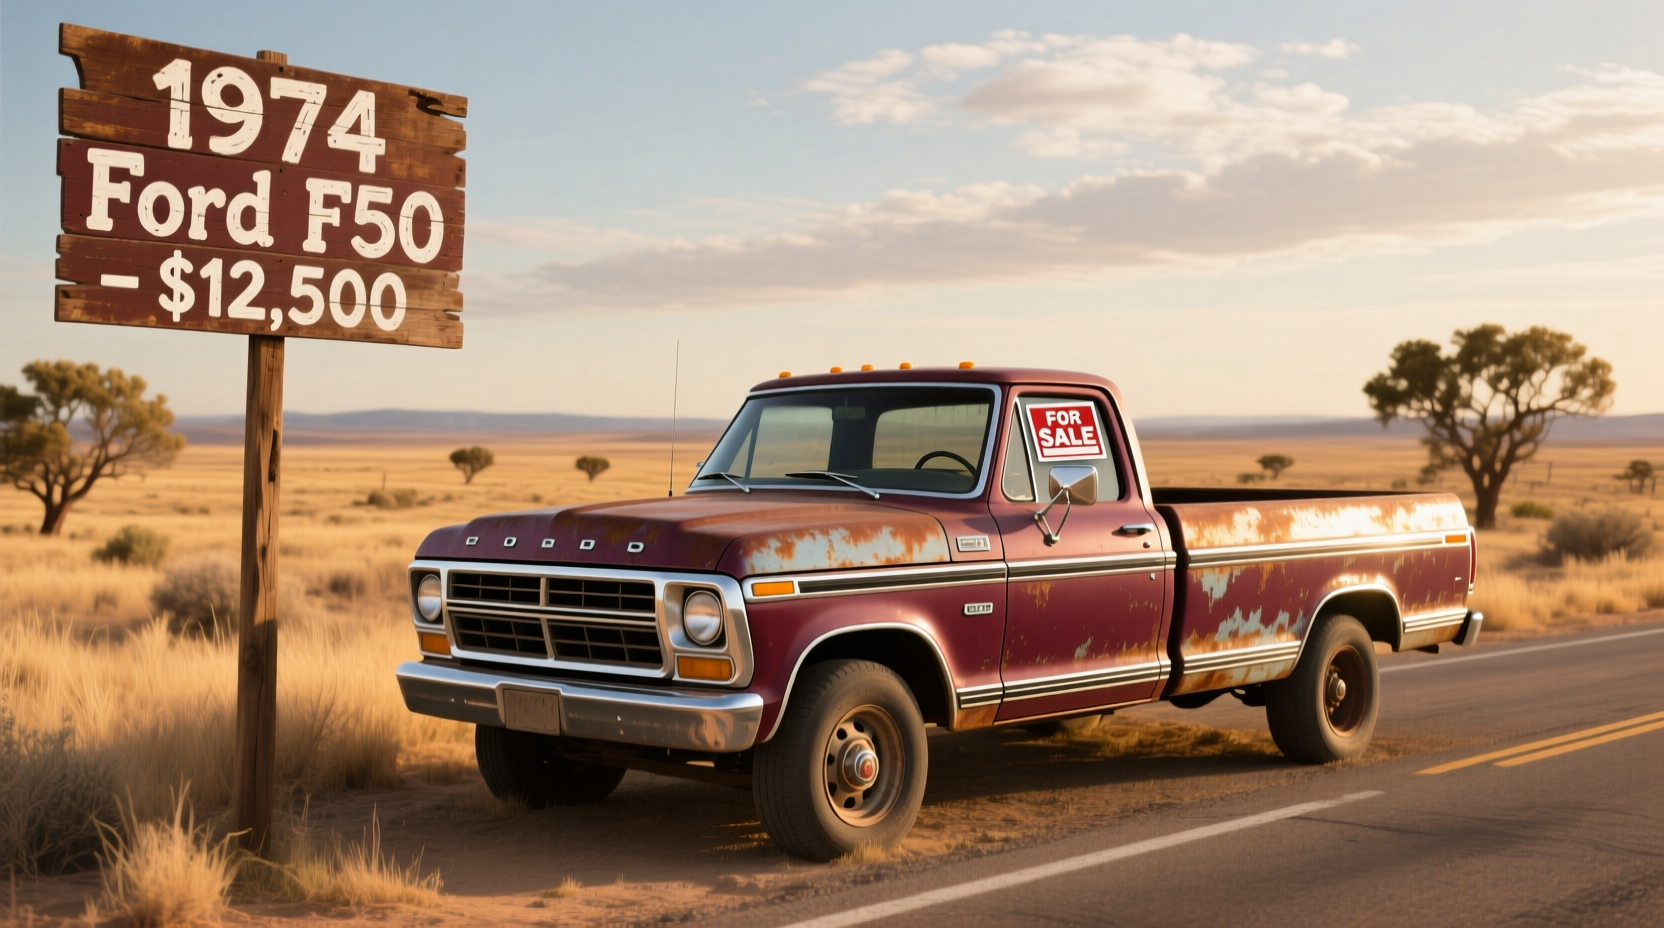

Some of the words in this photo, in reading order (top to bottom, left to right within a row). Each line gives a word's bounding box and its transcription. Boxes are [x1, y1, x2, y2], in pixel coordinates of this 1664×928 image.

[152, 58, 386, 174] 1974
[86, 148, 274, 247] Ford
[302, 177, 444, 264] F50
[158, 250, 407, 332] $12,500
[1038, 426, 1097, 447] SALE
[1045, 410, 1082, 426] FOR
